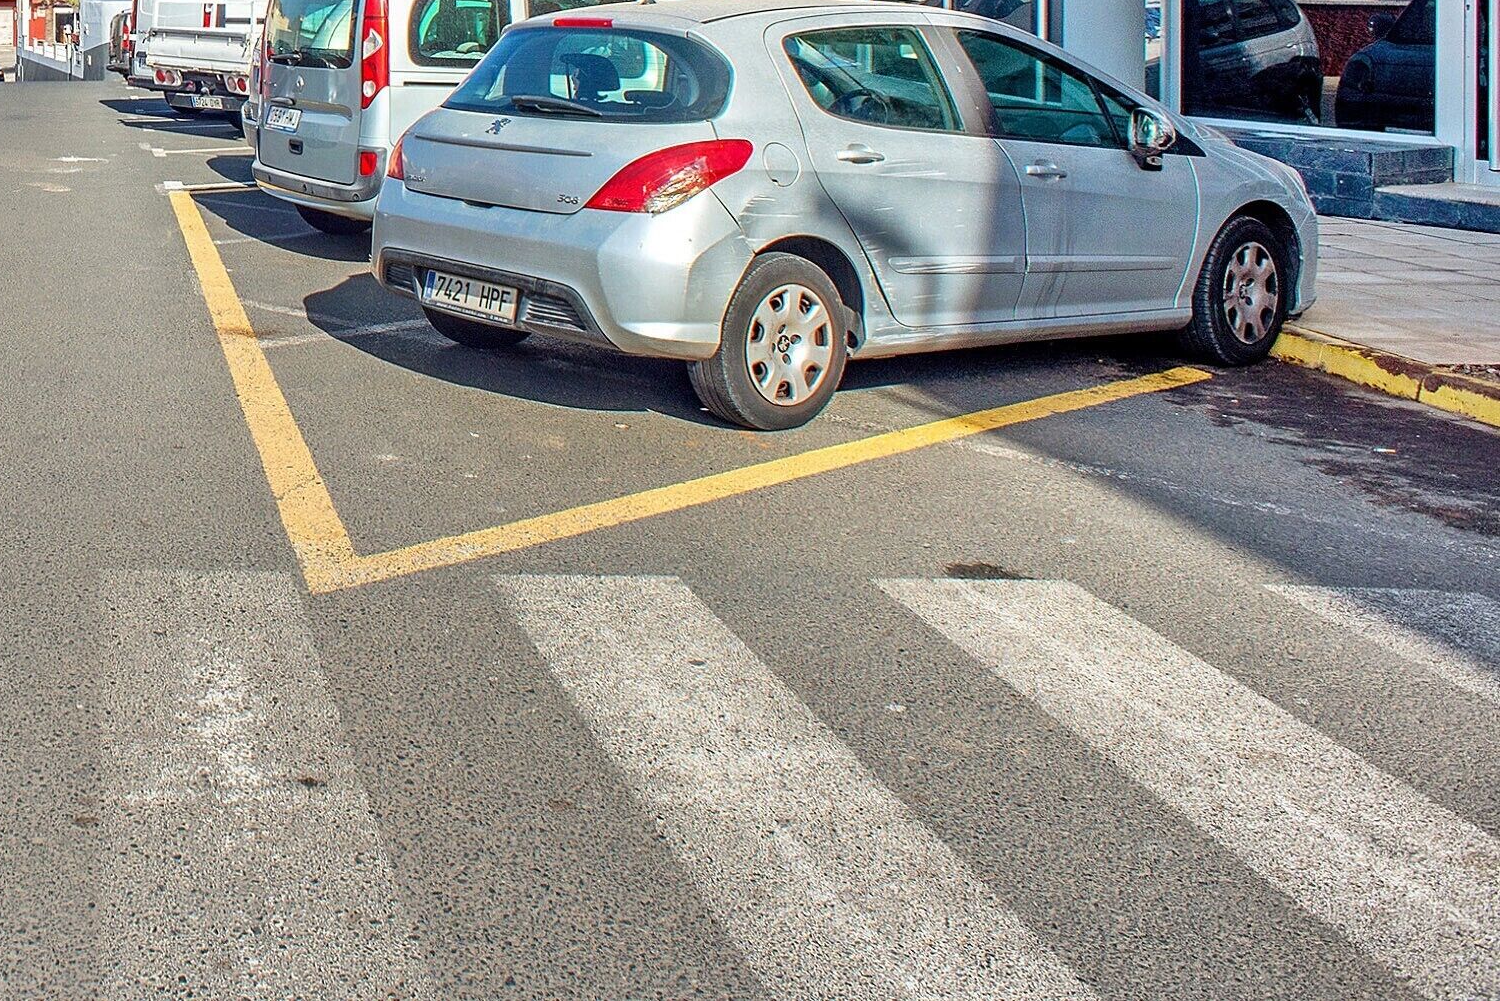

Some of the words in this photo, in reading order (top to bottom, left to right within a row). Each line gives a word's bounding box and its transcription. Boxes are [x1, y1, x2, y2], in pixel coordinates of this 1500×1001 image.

[557, 194, 579, 205] 308
[435, 275, 471, 304] 7421
[479, 285, 511, 312] HPF
